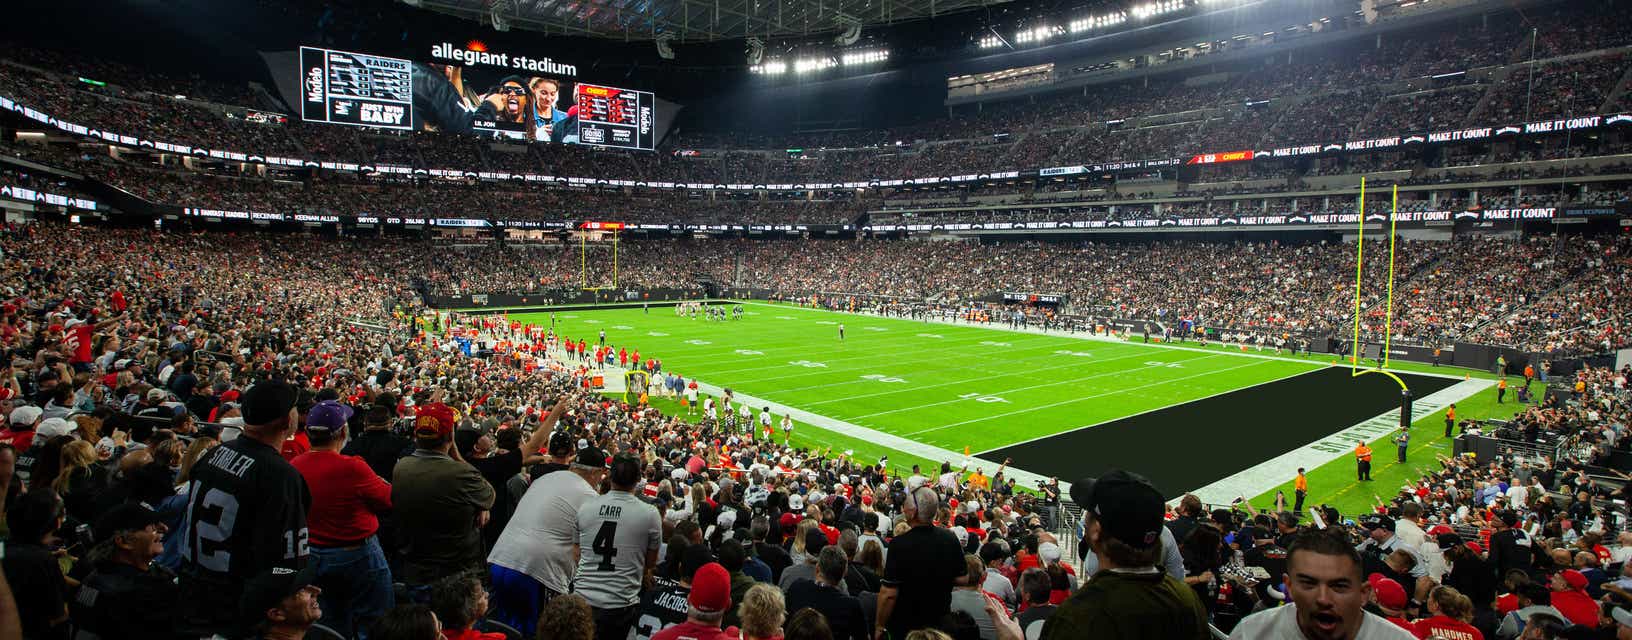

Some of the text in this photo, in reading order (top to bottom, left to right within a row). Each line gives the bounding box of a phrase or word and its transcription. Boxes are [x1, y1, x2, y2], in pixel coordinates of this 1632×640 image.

[366, 59, 406, 70] RAIDERS
[431, 42, 577, 76] allegiant stadium
[307, 67, 324, 103] Modelo
[360, 110, 405, 124] BABY
[640, 107, 651, 135] Modelo
[1526, 121, 1553, 133] MAKE
[1554, 120, 1565, 131] IT
[1565, 116, 1601, 129] COUNT
[1428, 132, 1452, 143] MAKE
[1452, 131, 1462, 141] IT
[1462, 128, 1492, 139] COUNT
[1273, 148, 1291, 156] MAKE
[1299, 145, 1321, 154] COUNT
[1345, 140, 1366, 150] MAKE
[1375, 137, 1400, 147] COUNT
[1240, 216, 1257, 225] MAKE
[1265, 216, 1287, 225] COUNT
[1309, 214, 1329, 223] MAKE
[1338, 213, 1361, 223] COUNT
[1390, 212, 1413, 222] MAKE
[1422, 211, 1451, 221] COUNT
[1483, 209, 1510, 219] MAKE
[1510, 209, 1522, 219] IT
[1522, 208, 1556, 218] COUNT
[208, 445, 255, 478] STABLER
[599, 504, 622, 519] CARR
[183, 479, 240, 573] 12
[283, 527, 310, 560] 12
[592, 520, 618, 572] 4
[654, 591, 689, 614] JACOBS
